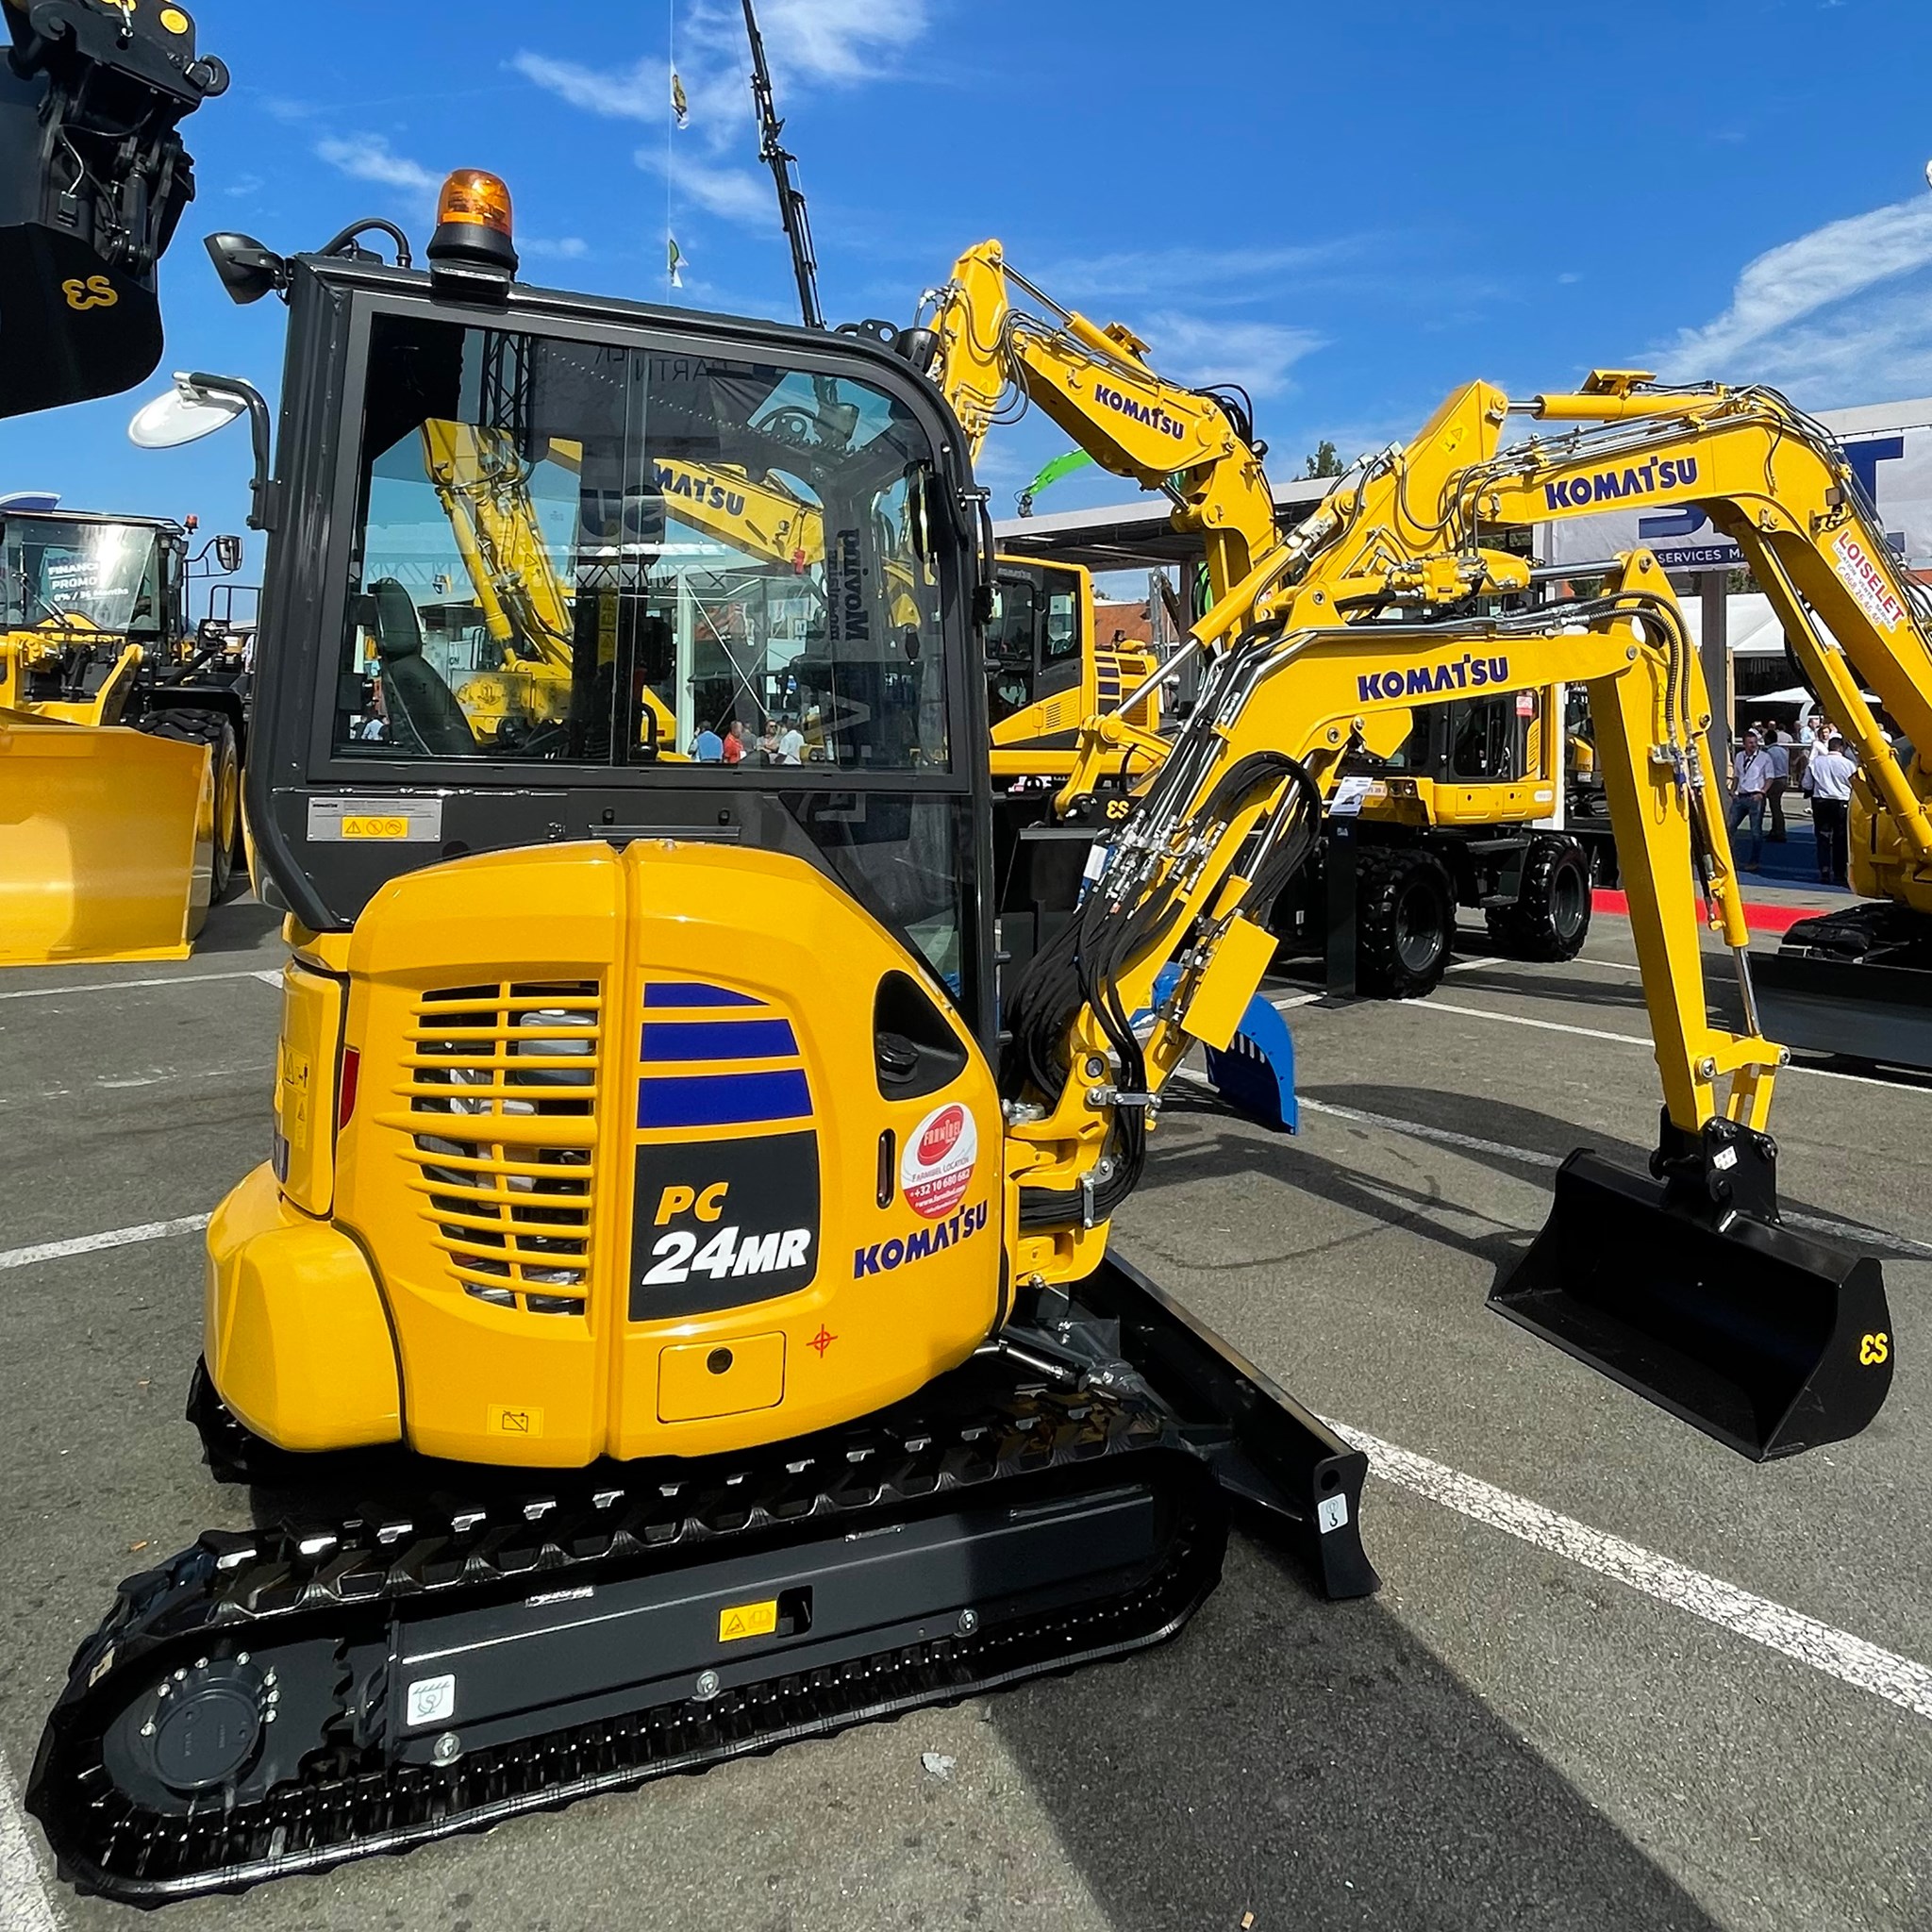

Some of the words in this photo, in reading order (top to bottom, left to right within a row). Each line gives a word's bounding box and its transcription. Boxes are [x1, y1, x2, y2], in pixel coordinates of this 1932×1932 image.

[1094, 383, 1184, 440] KOMATSU
[653, 466, 746, 516] MATSU
[1545, 455, 1698, 511] KOMATSU
[48, 562, 100, 575] FINANC
[1657, 549, 1722, 564] SERVICES
[1839, 531, 1905, 623] LOISELET
[52, 576, 98, 591] PROMO
[93, 587, 129, 597] Months
[1858, 578, 1874, 600] VENTE
[1357, 653, 1508, 702] KOMATSU
[655, 1182, 729, 1226] PC
[932, 1180, 942, 1192] 10
[641, 1225, 811, 1286] 24MR
[854, 1200, 988, 1279] KOMATSU
